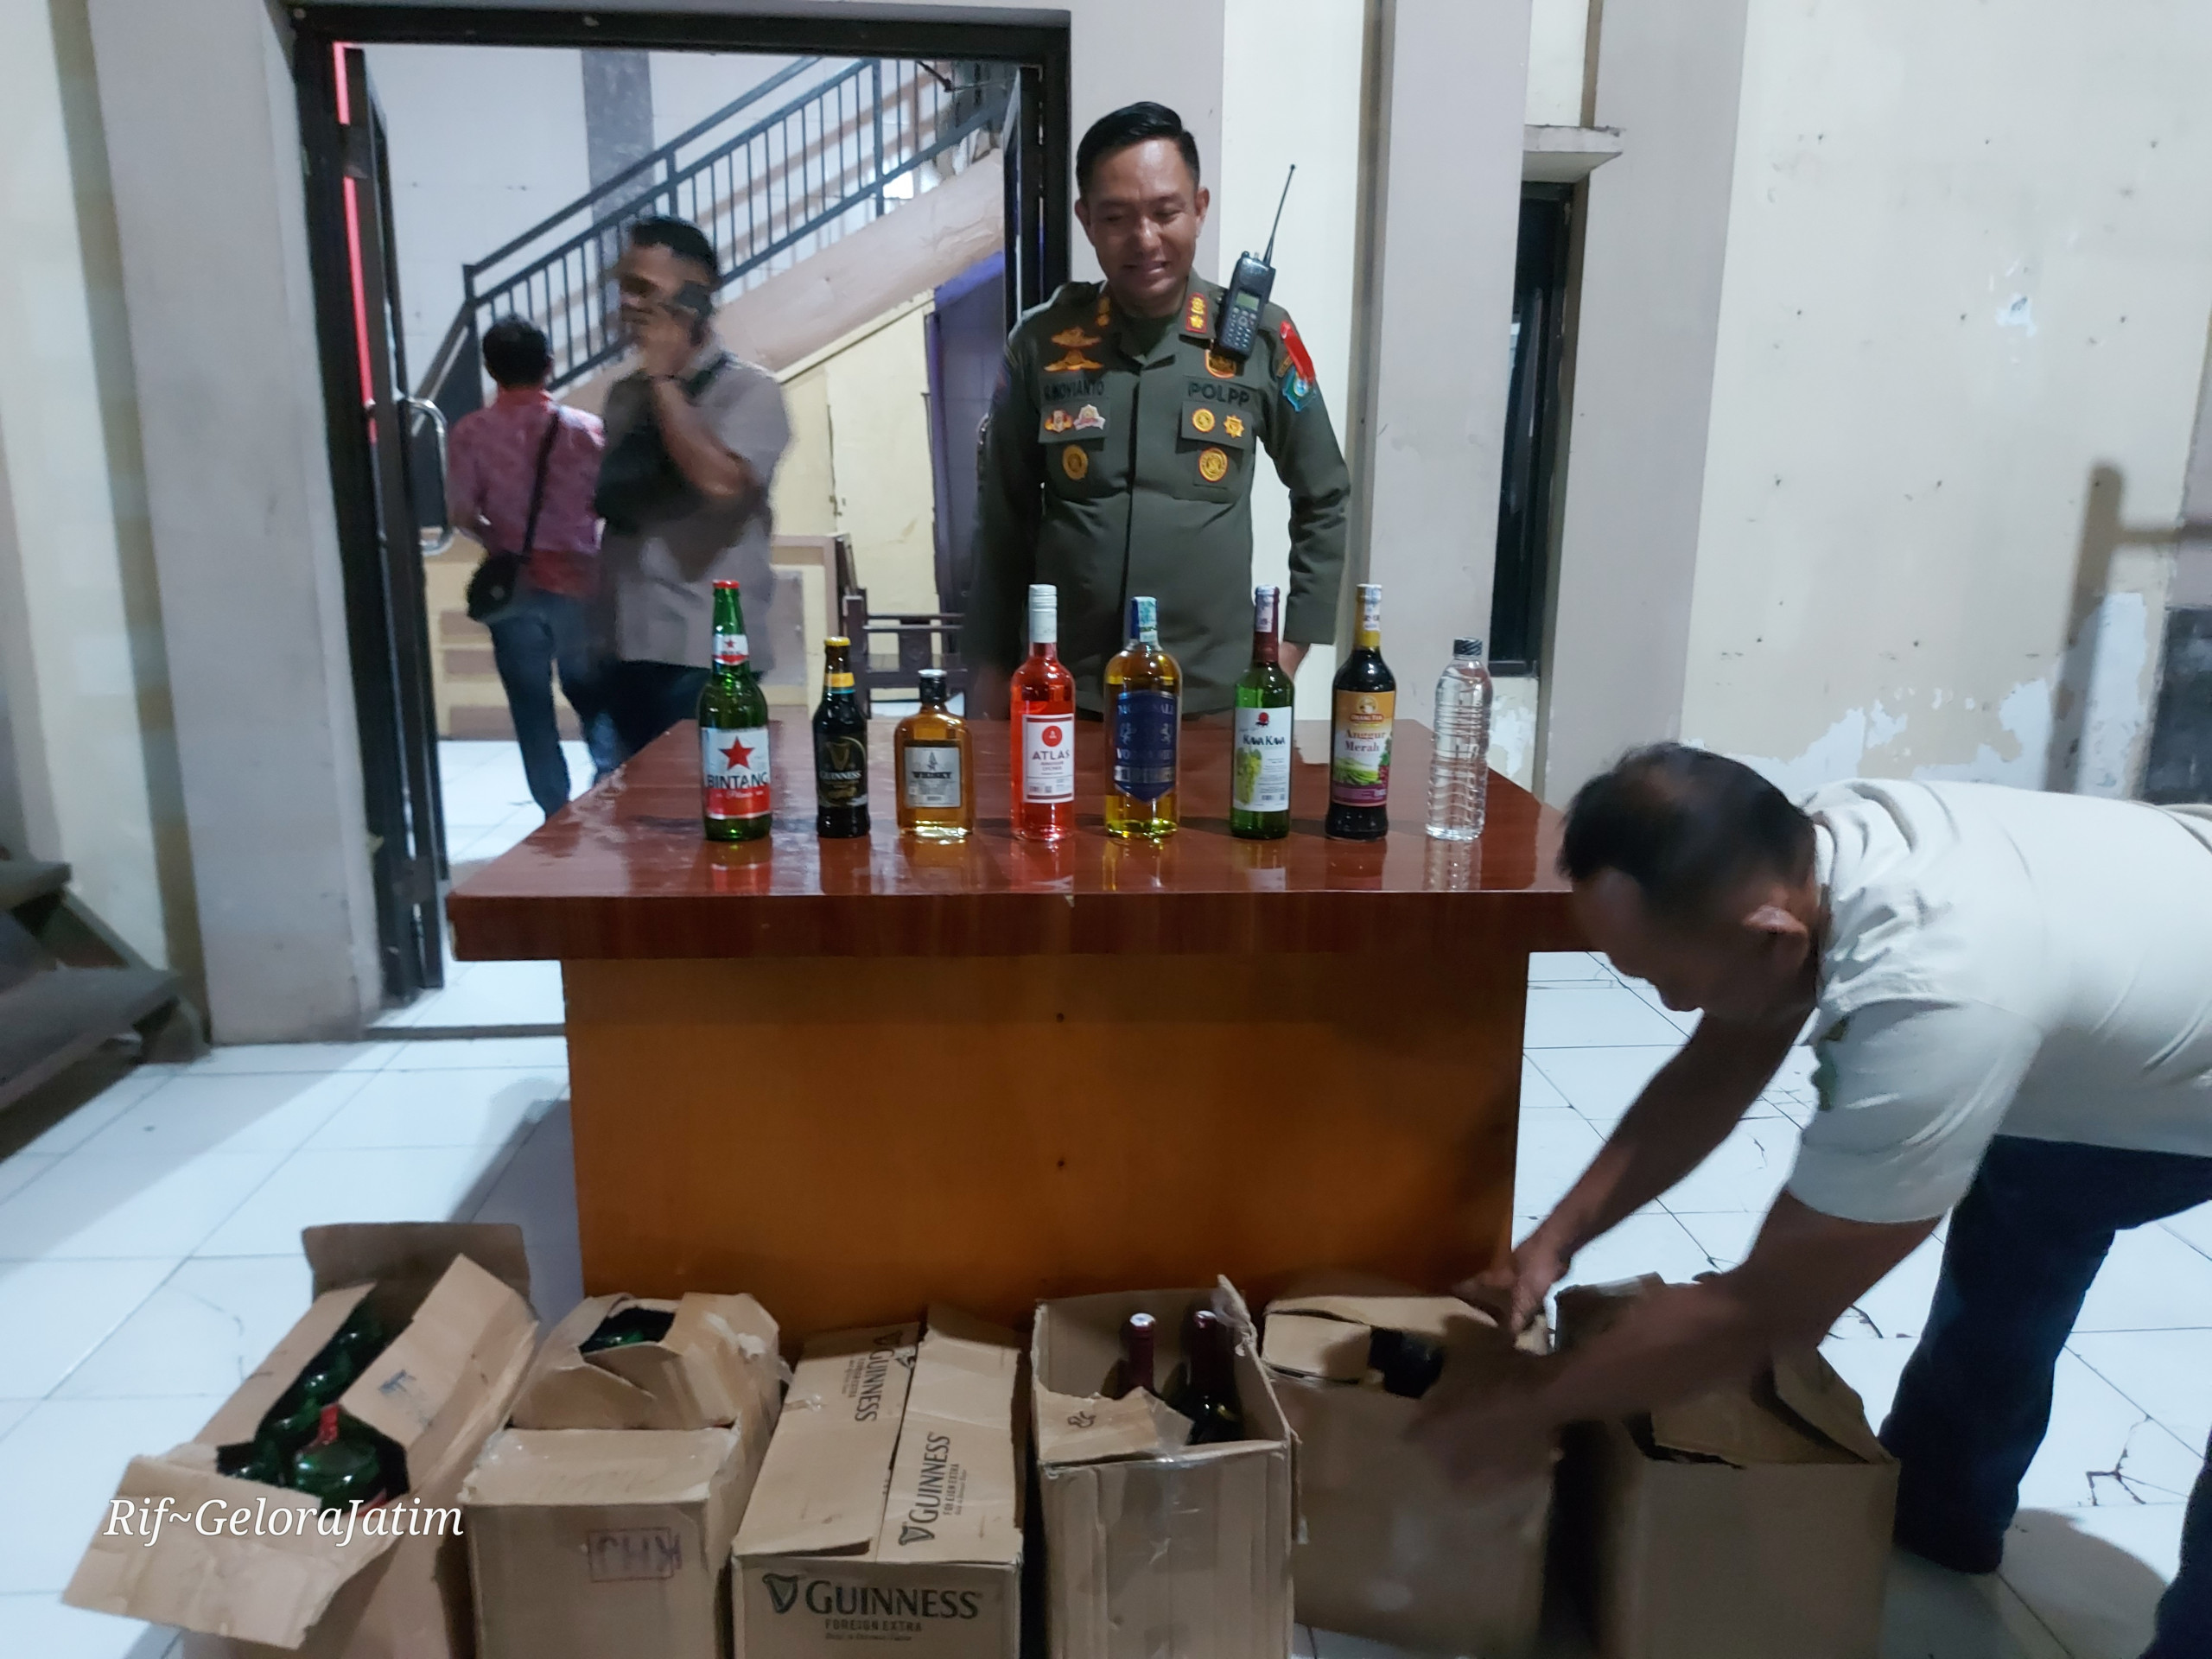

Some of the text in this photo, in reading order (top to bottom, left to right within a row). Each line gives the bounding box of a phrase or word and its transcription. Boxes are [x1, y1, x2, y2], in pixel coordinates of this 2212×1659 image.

[1188, 381, 1249, 407] POLPP
[1345, 729, 1386, 741] Anggur
[1032, 750, 1071, 760] ATLAS
[1345, 741, 1380, 752] Merah
[707, 772, 768, 790] BINTANG
[855, 1349, 895, 1421] GUINNESS
[909, 1431, 950, 1523] GUINNESS
[805, 1580, 979, 1619] GUINNESS
[825, 1618, 922, 1632] FOREIGN EXTRA
